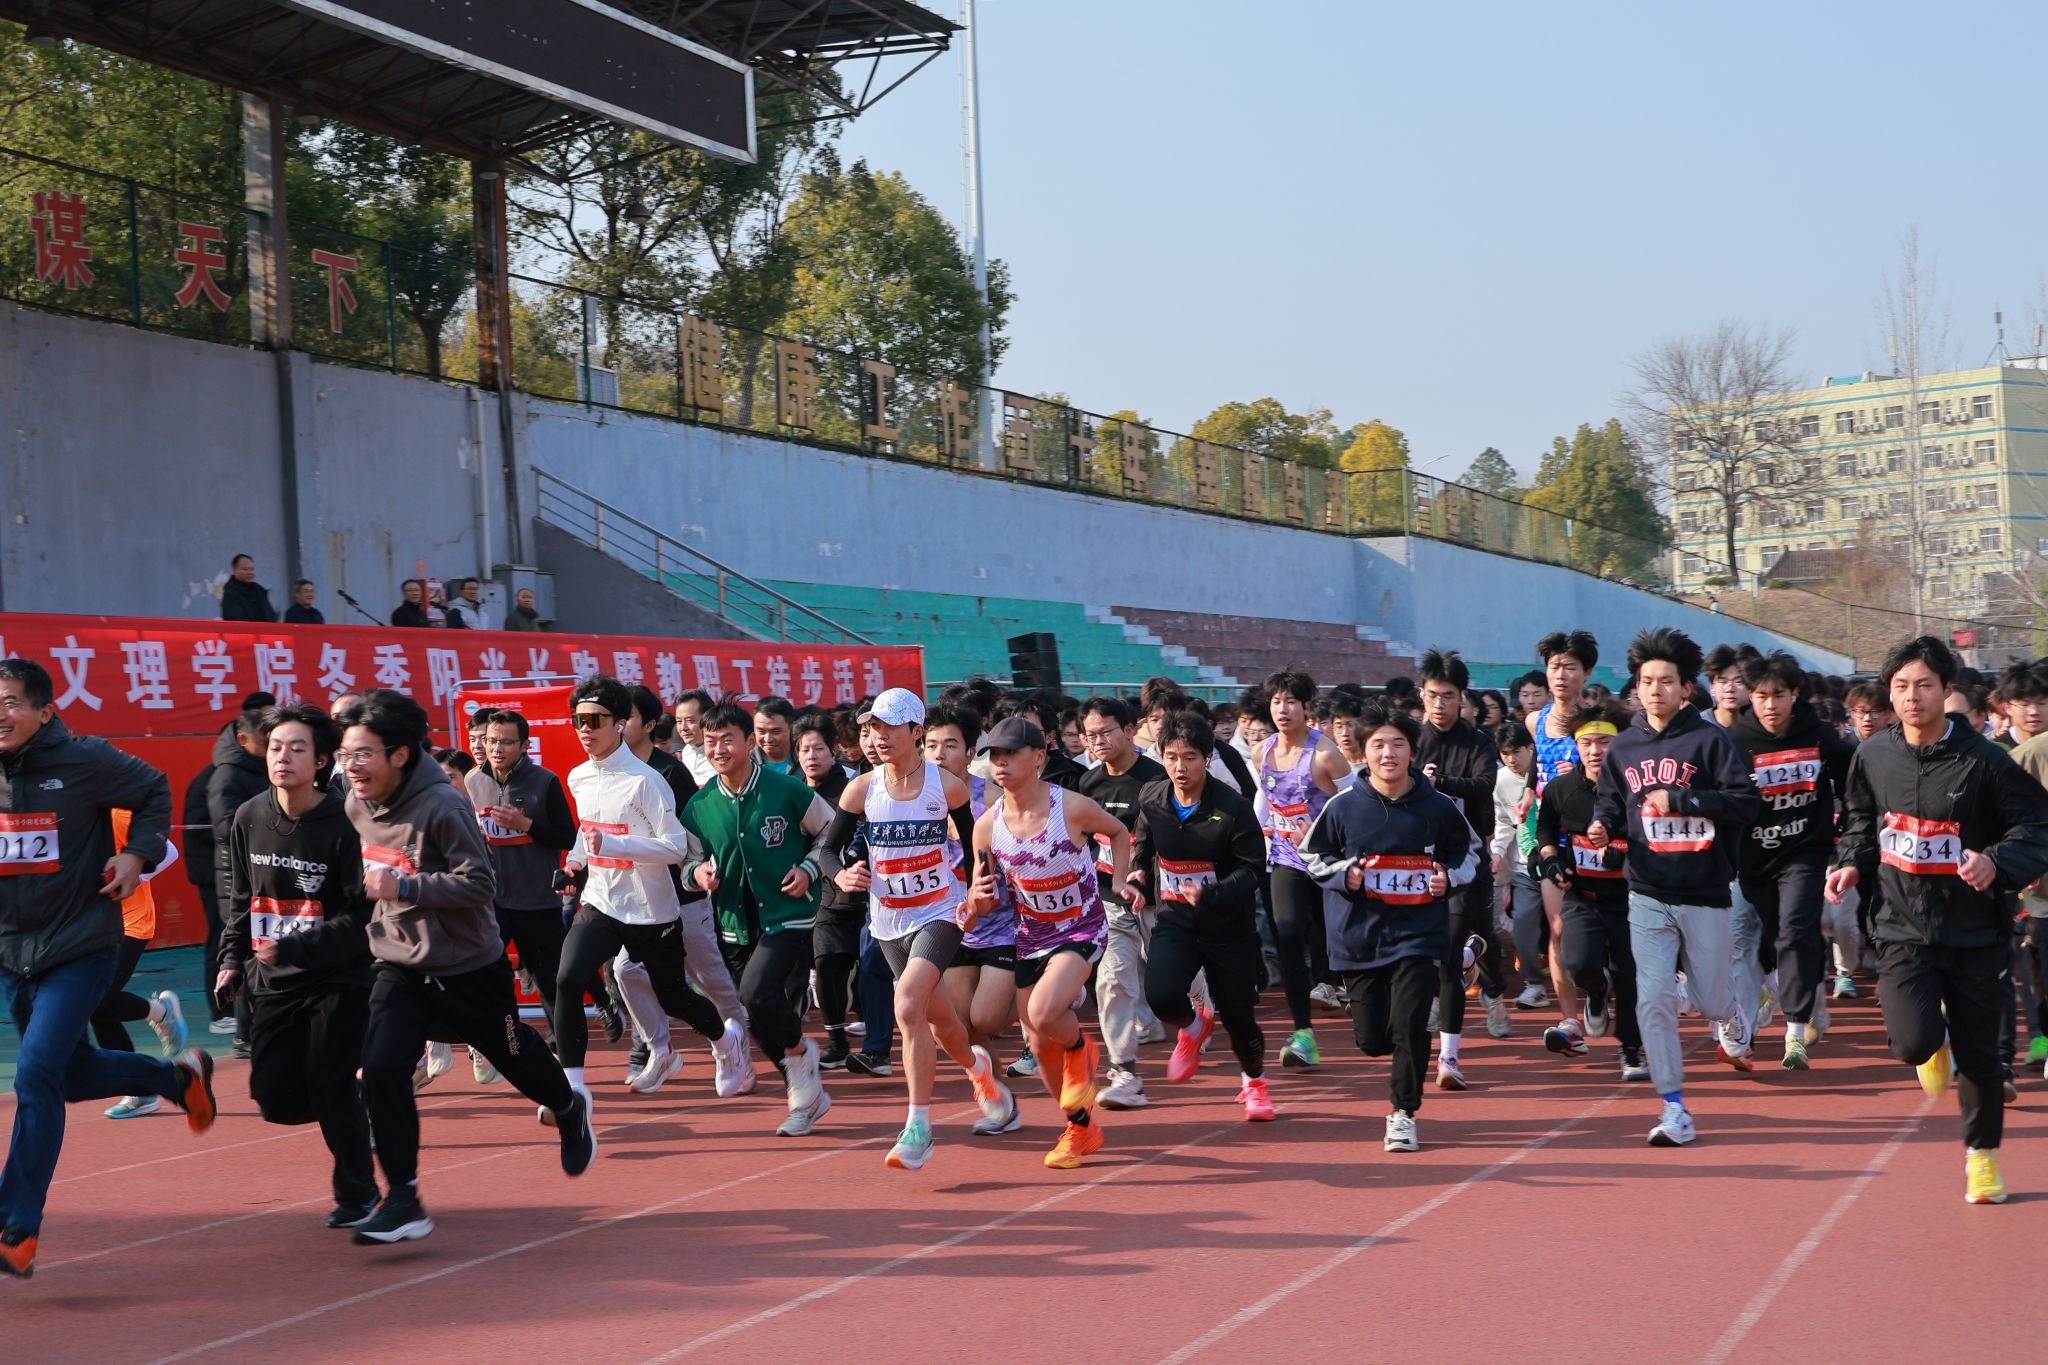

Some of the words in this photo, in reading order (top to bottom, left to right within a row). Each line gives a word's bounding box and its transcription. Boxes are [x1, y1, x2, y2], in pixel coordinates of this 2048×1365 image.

[30, 190, 358, 334] 谋天下
[0, 634, 886, 711] 文理学院冬季阳光长跑暨教职工徒步活动
[1763, 763, 1816, 785] 1249
[1649, 820, 1707, 839] 1444
[1887, 832, 1953, 861] 1234
[884, 868, 941, 896] 1135
[1373, 872, 1428, 891] 1443
